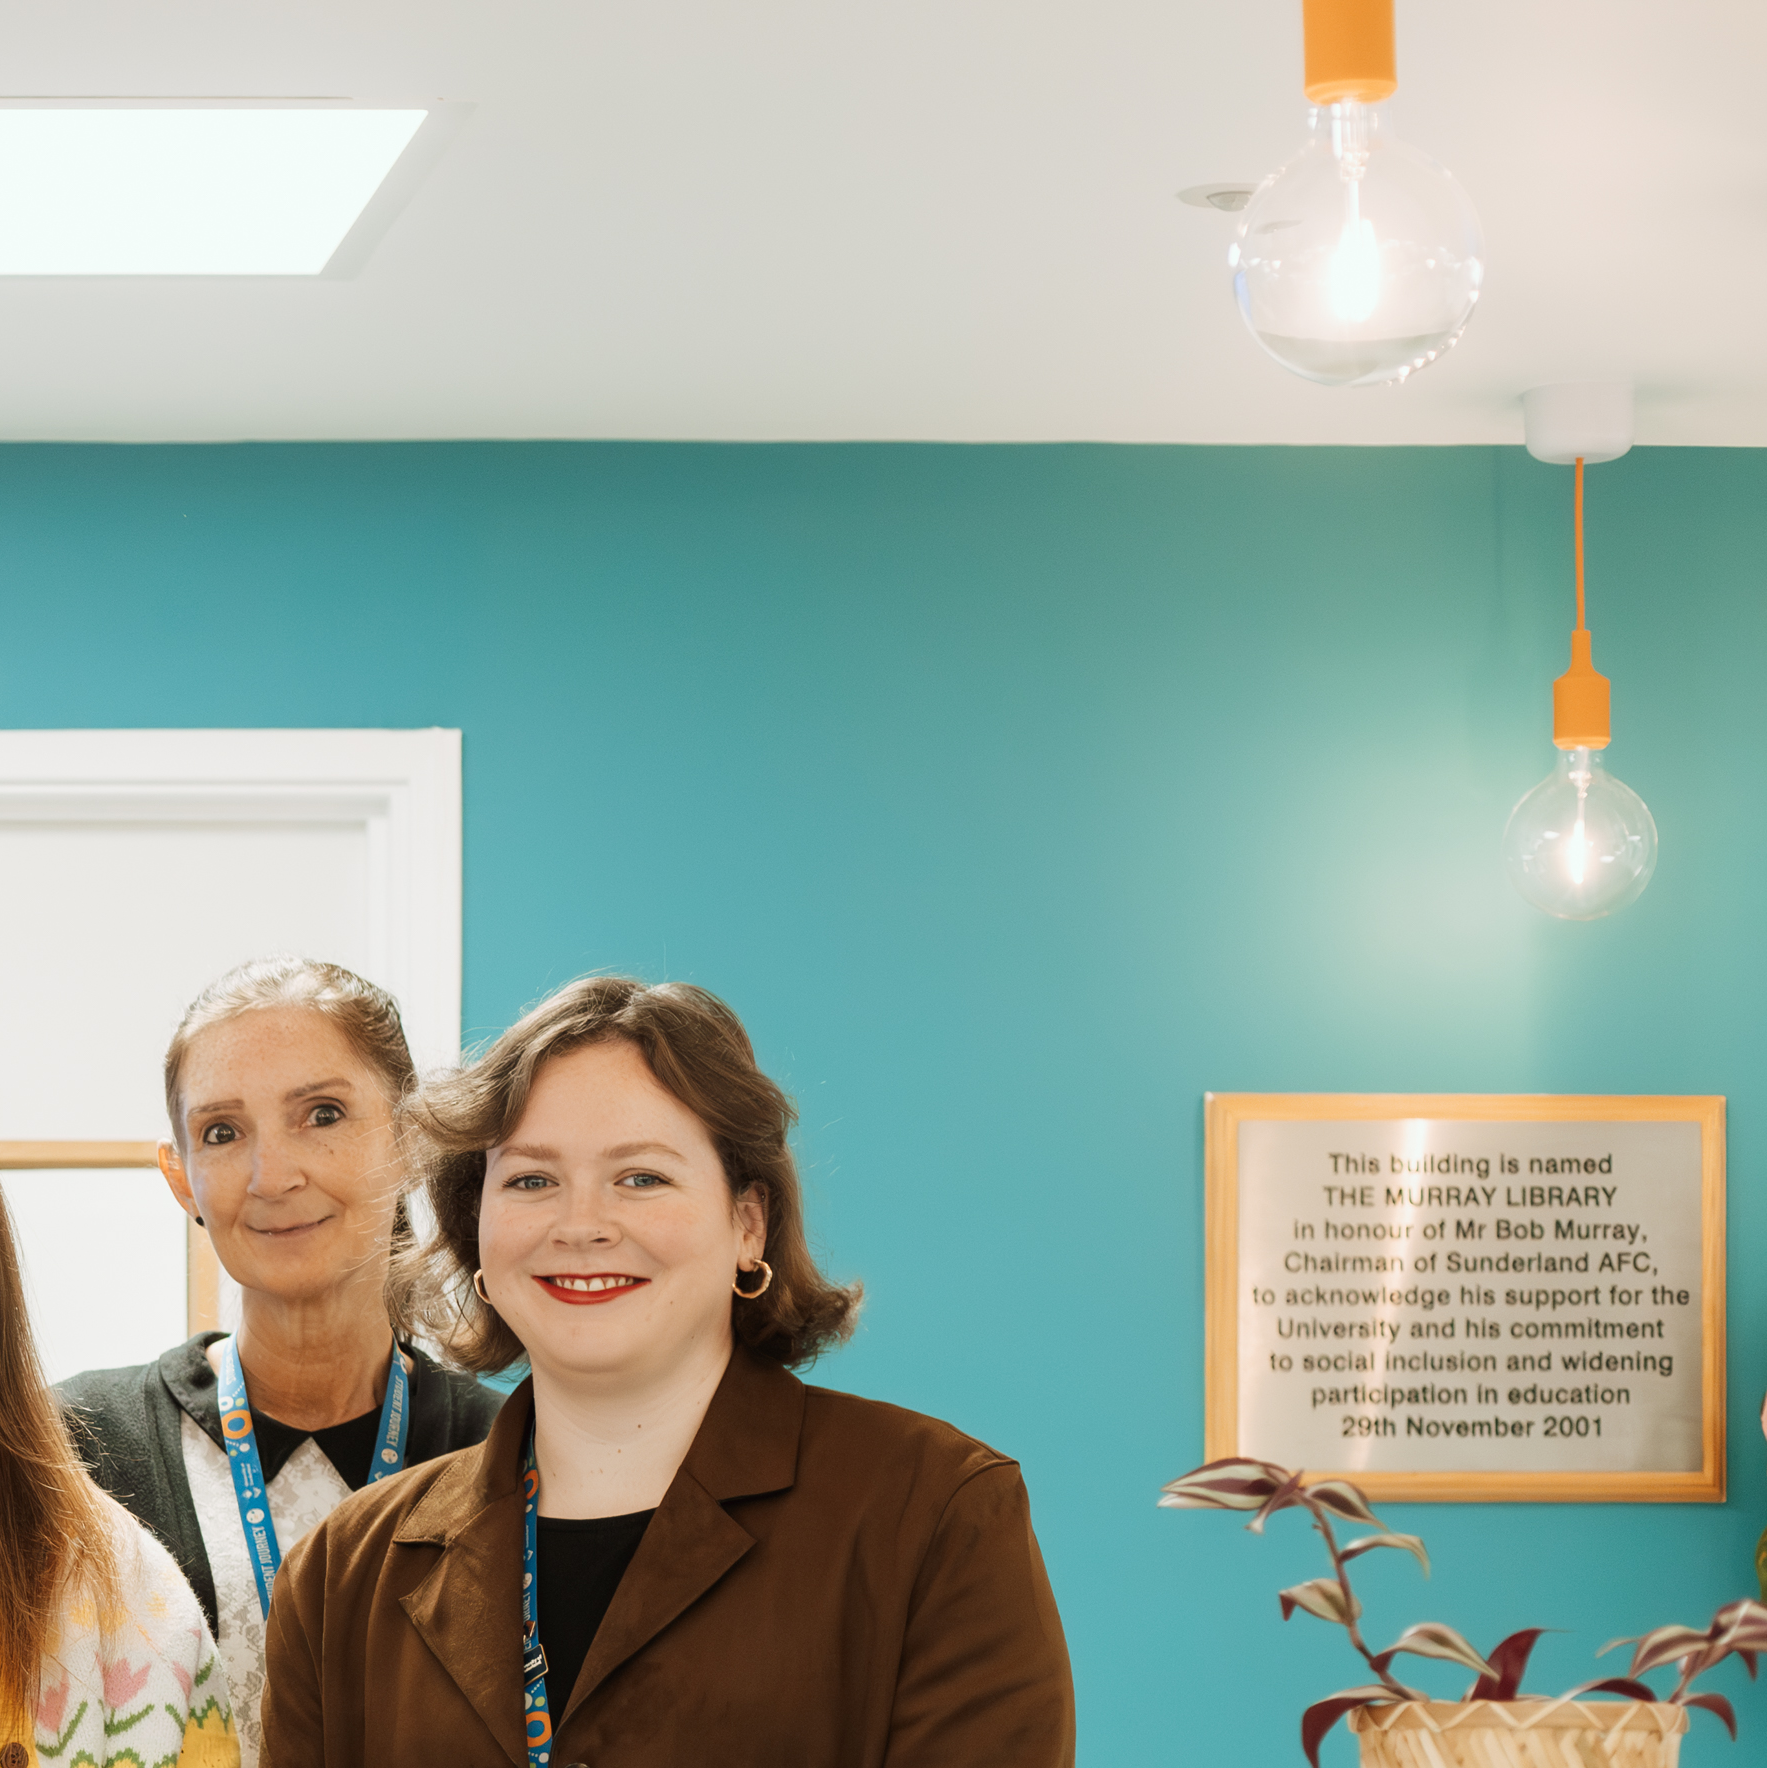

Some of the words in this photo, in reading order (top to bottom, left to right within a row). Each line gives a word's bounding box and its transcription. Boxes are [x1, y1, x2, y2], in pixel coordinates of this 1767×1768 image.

[1329, 1152, 1380, 1174] This
[1391, 1153, 1490, 1179] building
[1500, 1153, 1519, 1174] is
[1529, 1153, 1612, 1174] named
[1324, 1186, 1373, 1207] THE
[1385, 1186, 1496, 1208] MURRAY
[1507, 1186, 1617, 1208] LIBRARY
[1295, 1218, 1314, 1241] in
[1325, 1220, 1413, 1241] honour
[1423, 1219, 1445, 1241] of
[1455, 1219, 1486, 1241] Mr
[1496, 1219, 1544, 1241] Bob
[1555, 1219, 1647, 1246] Murray,
[1285, 1251, 1403, 1273] Chairman
[1414, 1252, 1437, 1273] of
[1447, 1250, 1589, 1273] Sunderland
[1599, 1251, 1657, 1276] AFC,
[1253, 1288, 1275, 1306] to
[1286, 1286, 1450, 1312] acknowledge
[1460, 1285, 1495, 1307] his
[1505, 1286, 1601, 1312] support
[1609, 1285, 1643, 1307] for
[1651, 1285, 1690, 1307] the
[1278, 1317, 1400, 1345] University
[1410, 1317, 1455, 1339] and
[1466, 1317, 1500, 1339] his
[1510, 1318, 1664, 1340] commitment
[1270, 1353, 1293, 1372] to
[1303, 1350, 1374, 1373] social
[1386, 1350, 1496, 1372] inclusion
[1507, 1350, 1552, 1372] and
[1561, 1351, 1673, 1378] widening
[1312, 1382, 1467, 1409] participation
[1477, 1384, 1498, 1405] in
[1507, 1383, 1630, 1406] education
[1342, 1416, 1396, 1438] 29th
[1407, 1415, 1534, 1438] November
[1544, 1415, 1601, 1438] 2001
[252, 1526, 272, 1564] JOURNEY
